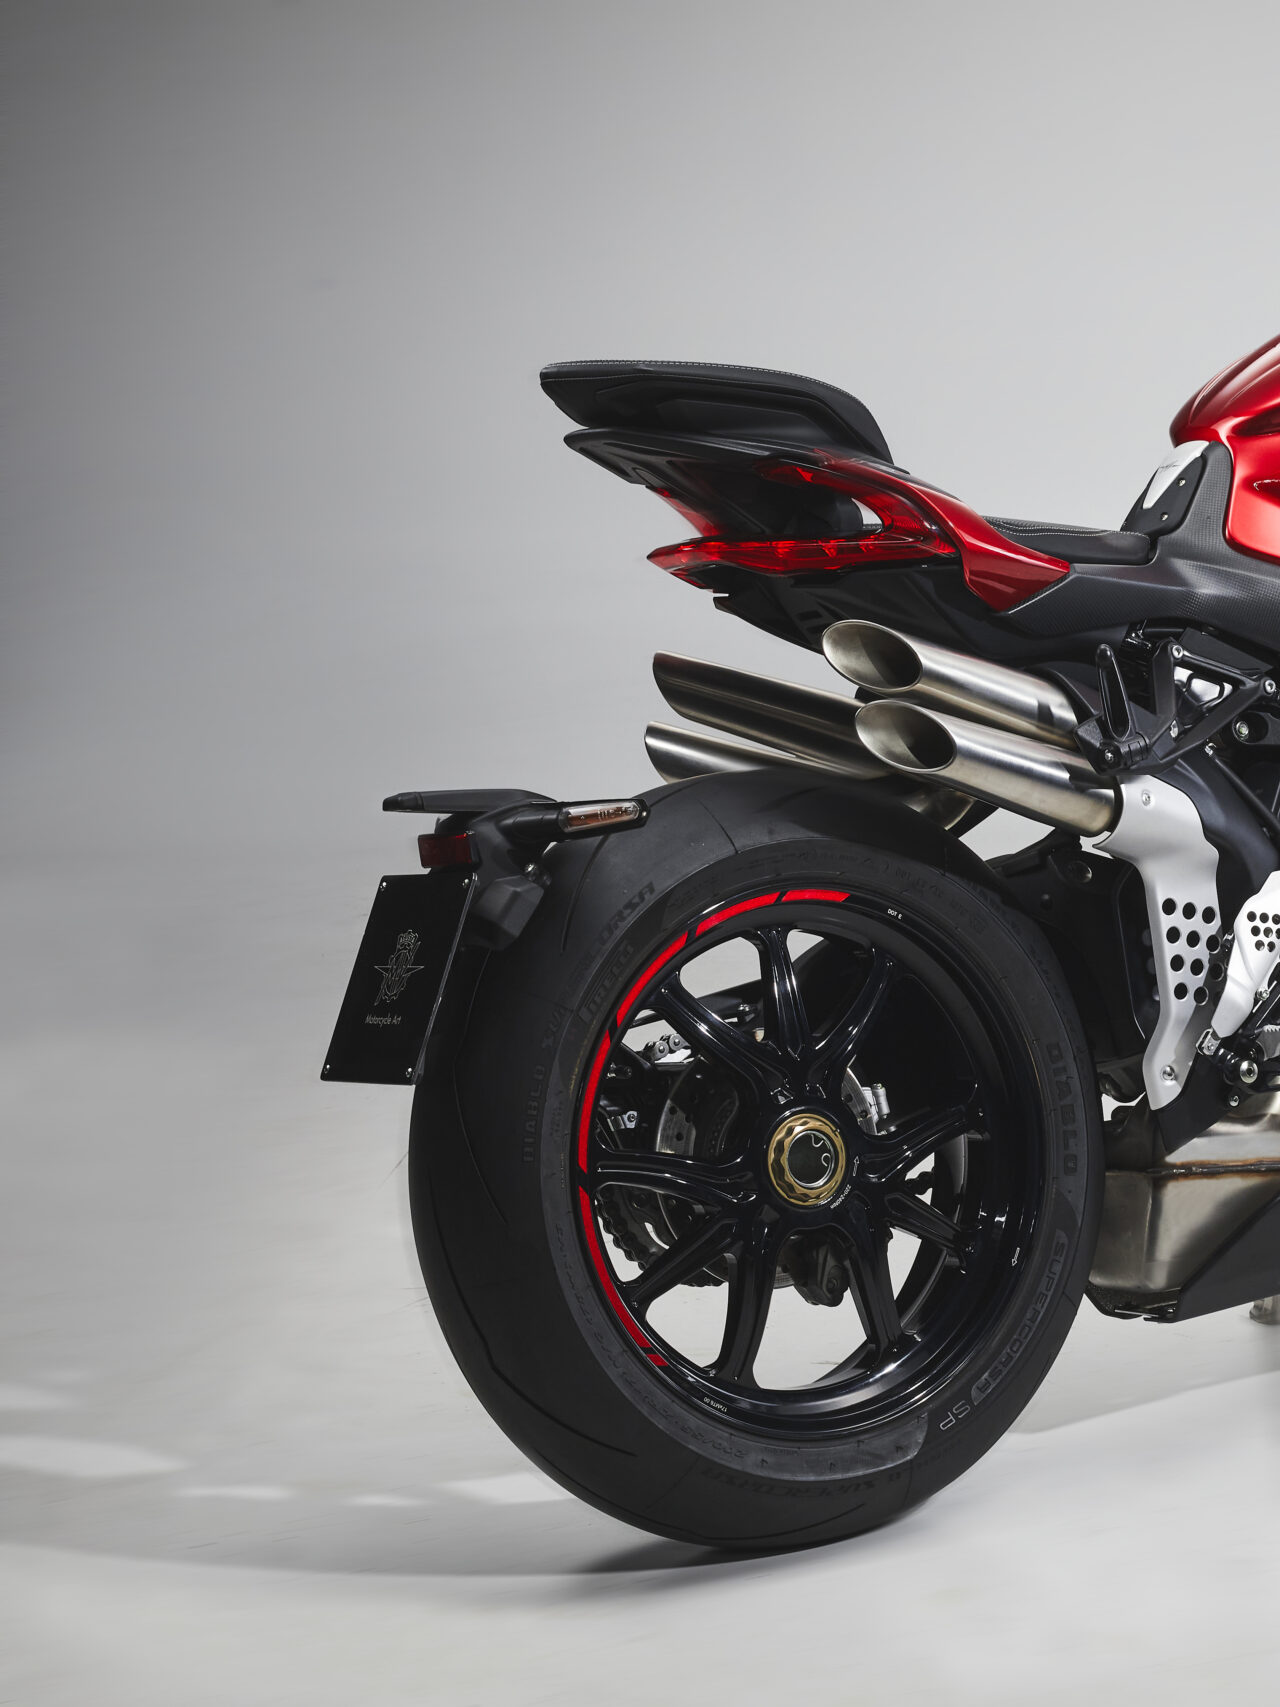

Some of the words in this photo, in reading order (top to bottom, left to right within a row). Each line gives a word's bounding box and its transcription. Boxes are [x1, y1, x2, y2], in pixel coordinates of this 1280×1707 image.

[365, 1013, 391, 1028] Motorcycle
[391, 1015, 402, 1026] Art
[520, 1064, 546, 1163] DIABLO
[1045, 1041, 1079, 1176] DIABLO
[977, 1241, 1066, 1394] SUPERCORSA
[938, 1399, 971, 1432] SP
